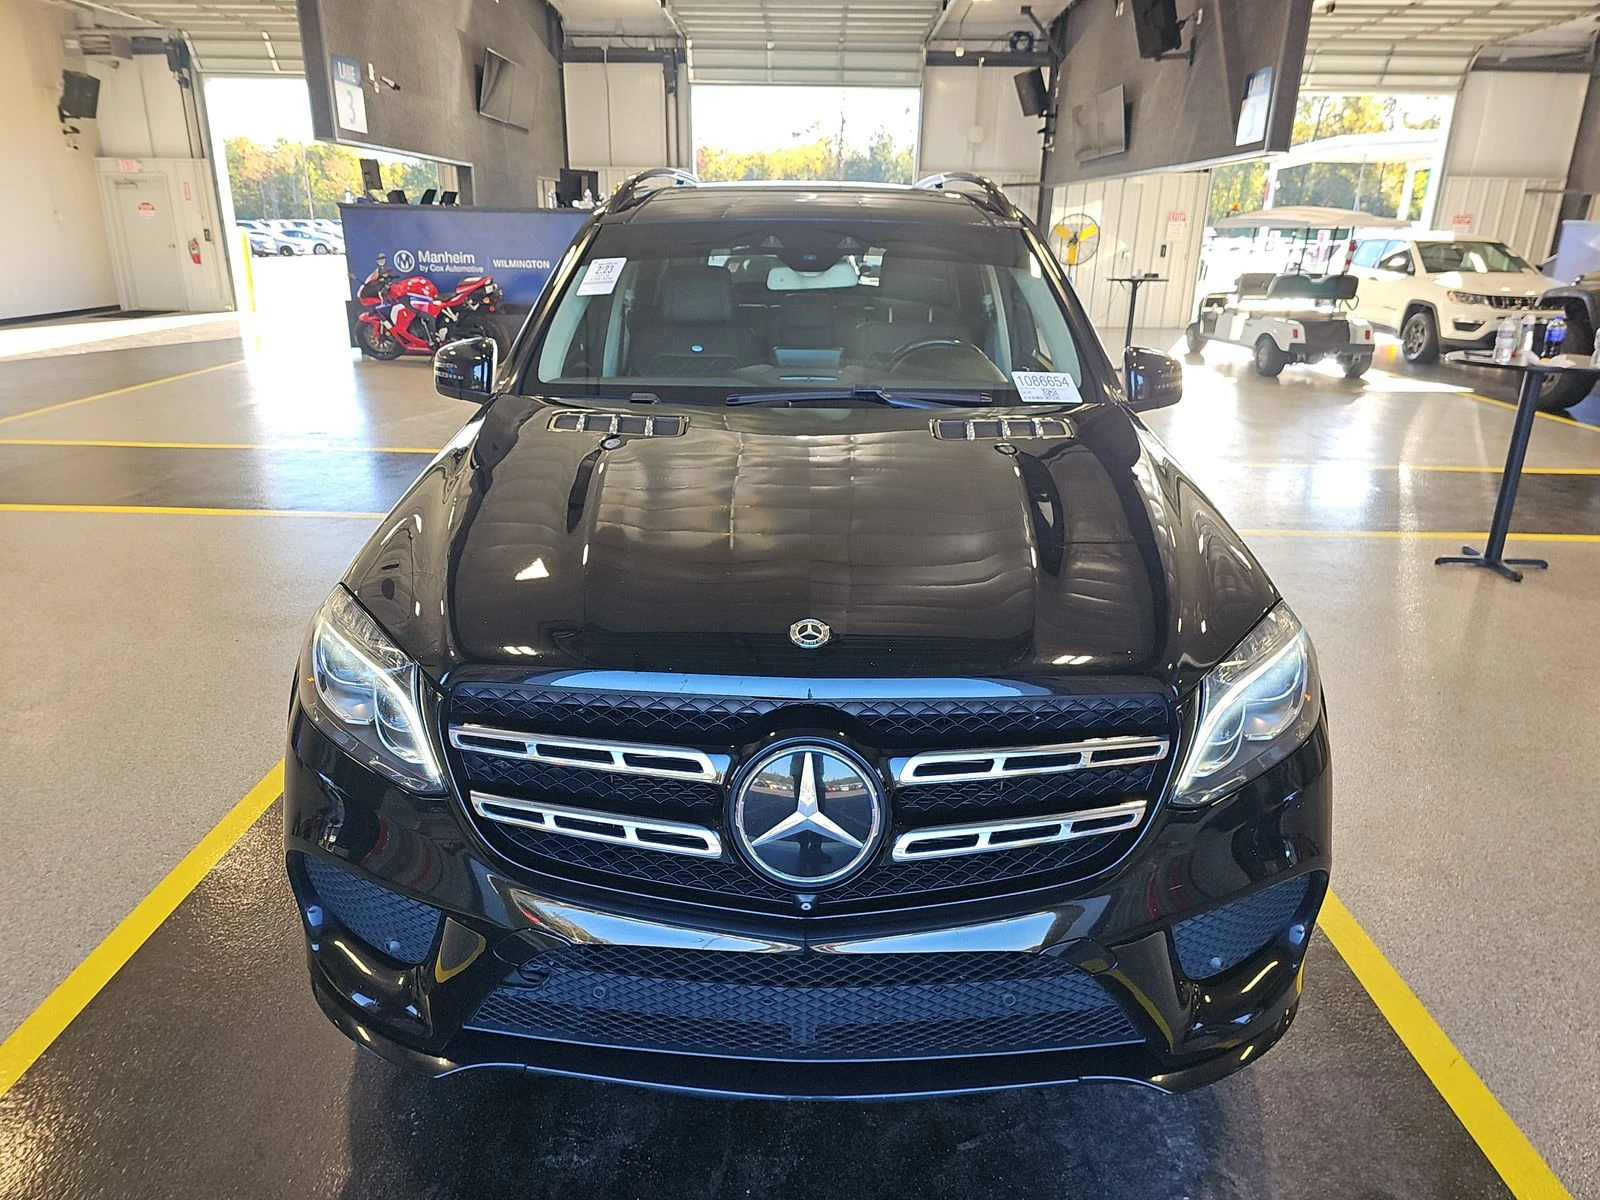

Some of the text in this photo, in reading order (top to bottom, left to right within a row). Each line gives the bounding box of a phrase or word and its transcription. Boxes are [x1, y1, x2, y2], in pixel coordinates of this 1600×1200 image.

[346, 89, 356, 124] 3
[417, 250, 475, 264] Manheim
[419, 264, 484, 273] by Cox Automotive
[492, 258, 550, 269] WILMINGTON
[1017, 375, 1070, 387] 1086654
